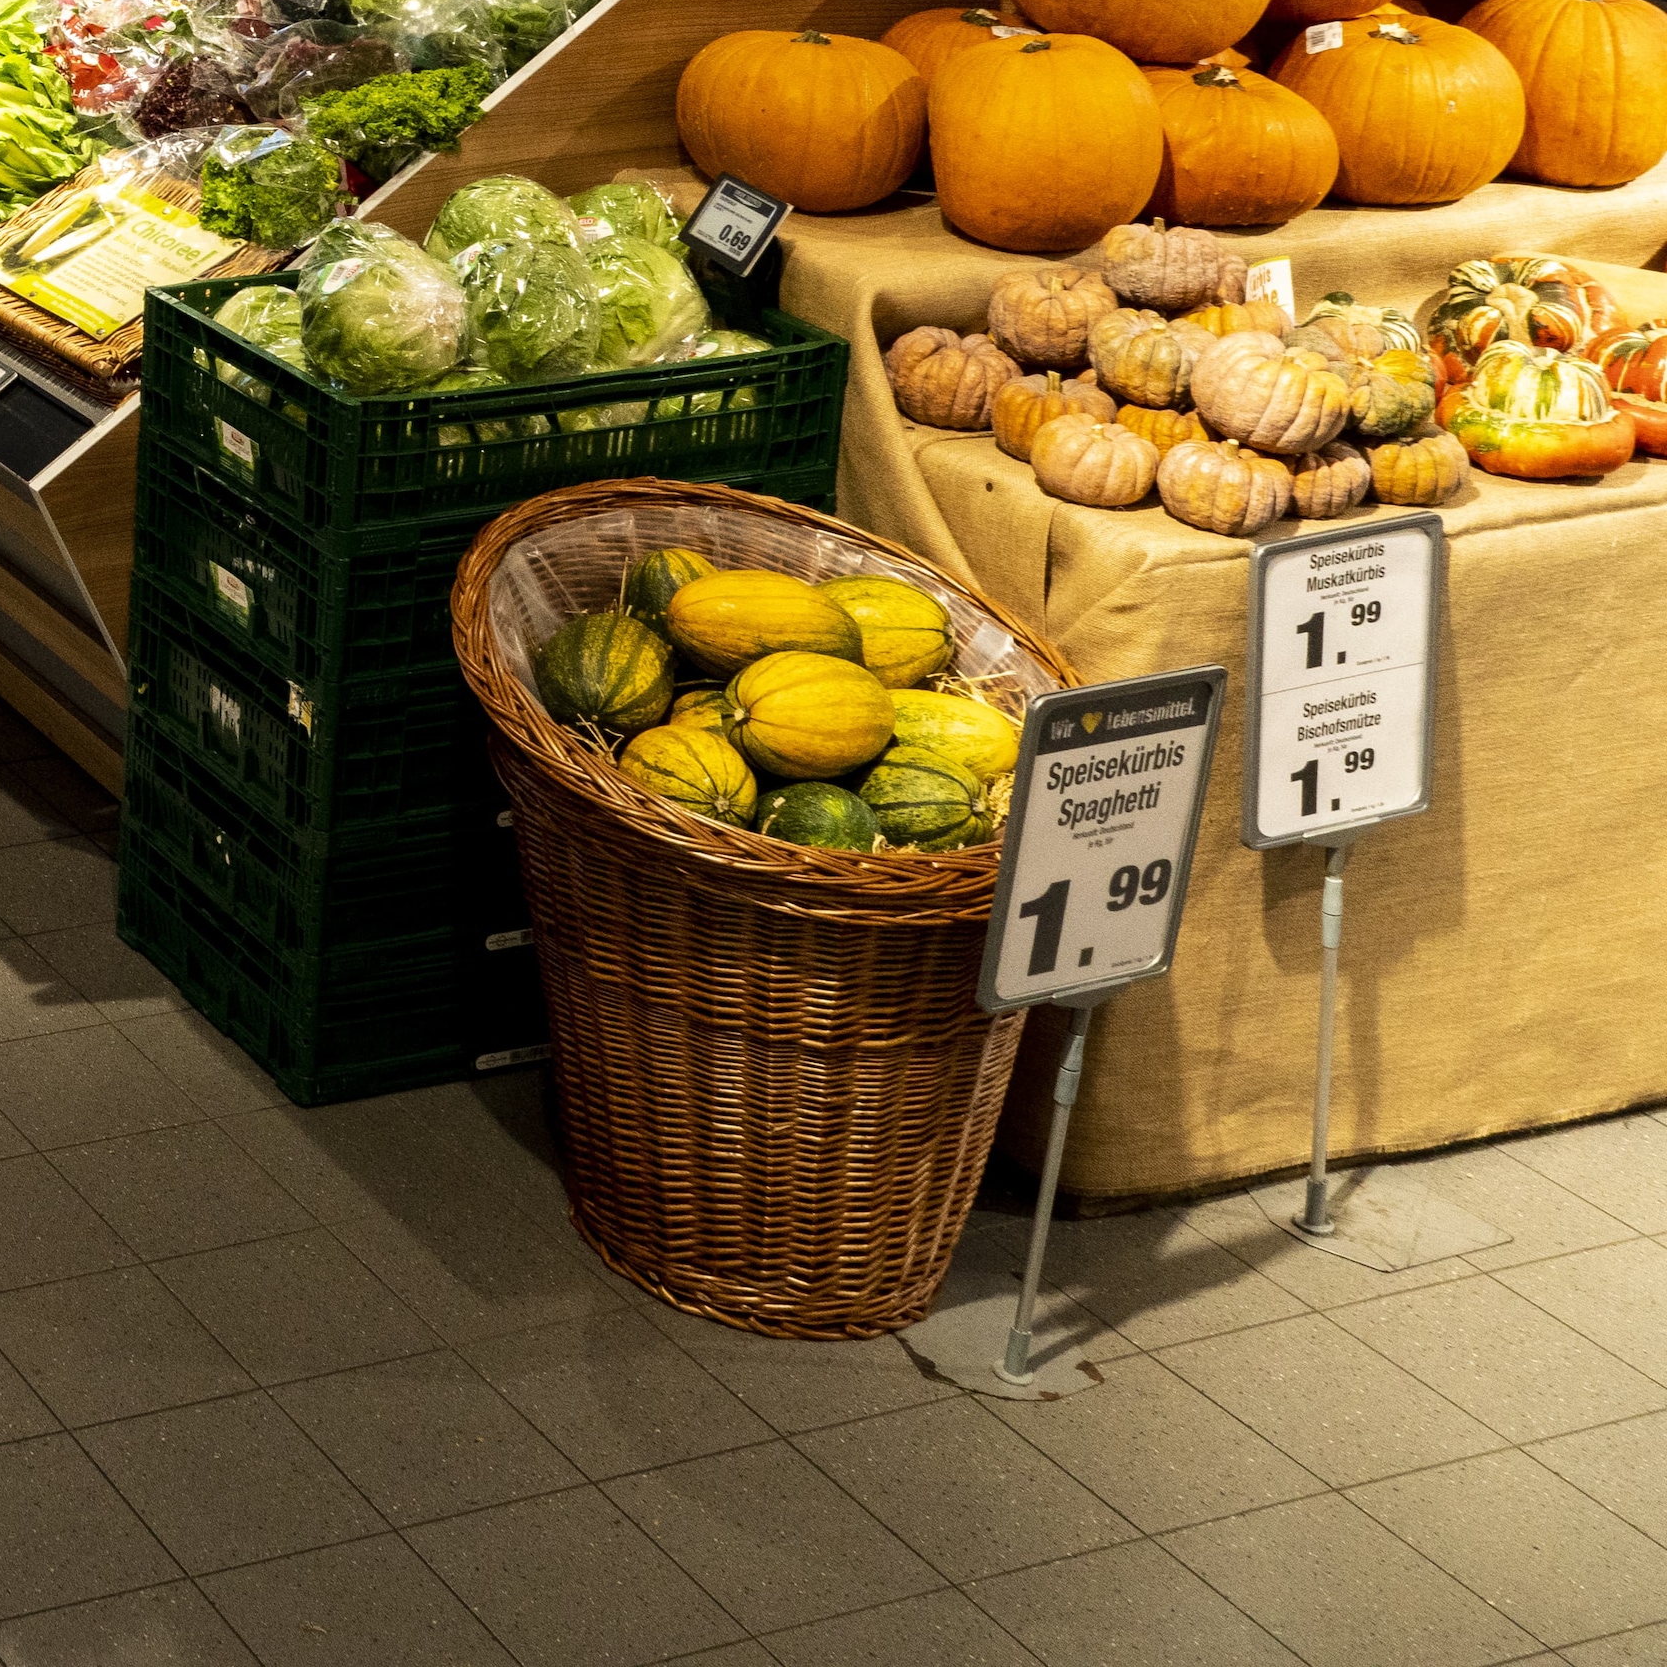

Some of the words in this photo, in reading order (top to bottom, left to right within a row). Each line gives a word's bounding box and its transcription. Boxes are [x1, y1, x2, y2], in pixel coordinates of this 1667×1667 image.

[718, 223, 750, 252] 0.69
[1309, 542, 1384, 570] Speisekürbis
[1306, 564, 1386, 593] Muskatkürbis
[1050, 720, 1074, 740] Wir
[1107, 697, 1195, 730] Lebensmittel.
[1303, 690, 1377, 719] Speisekürbis
[1297, 711, 1382, 742] Bischofsmütze
[1046, 740, 1186, 795] Speisekürbis
[1057, 781, 1162, 831] Spaghetti
